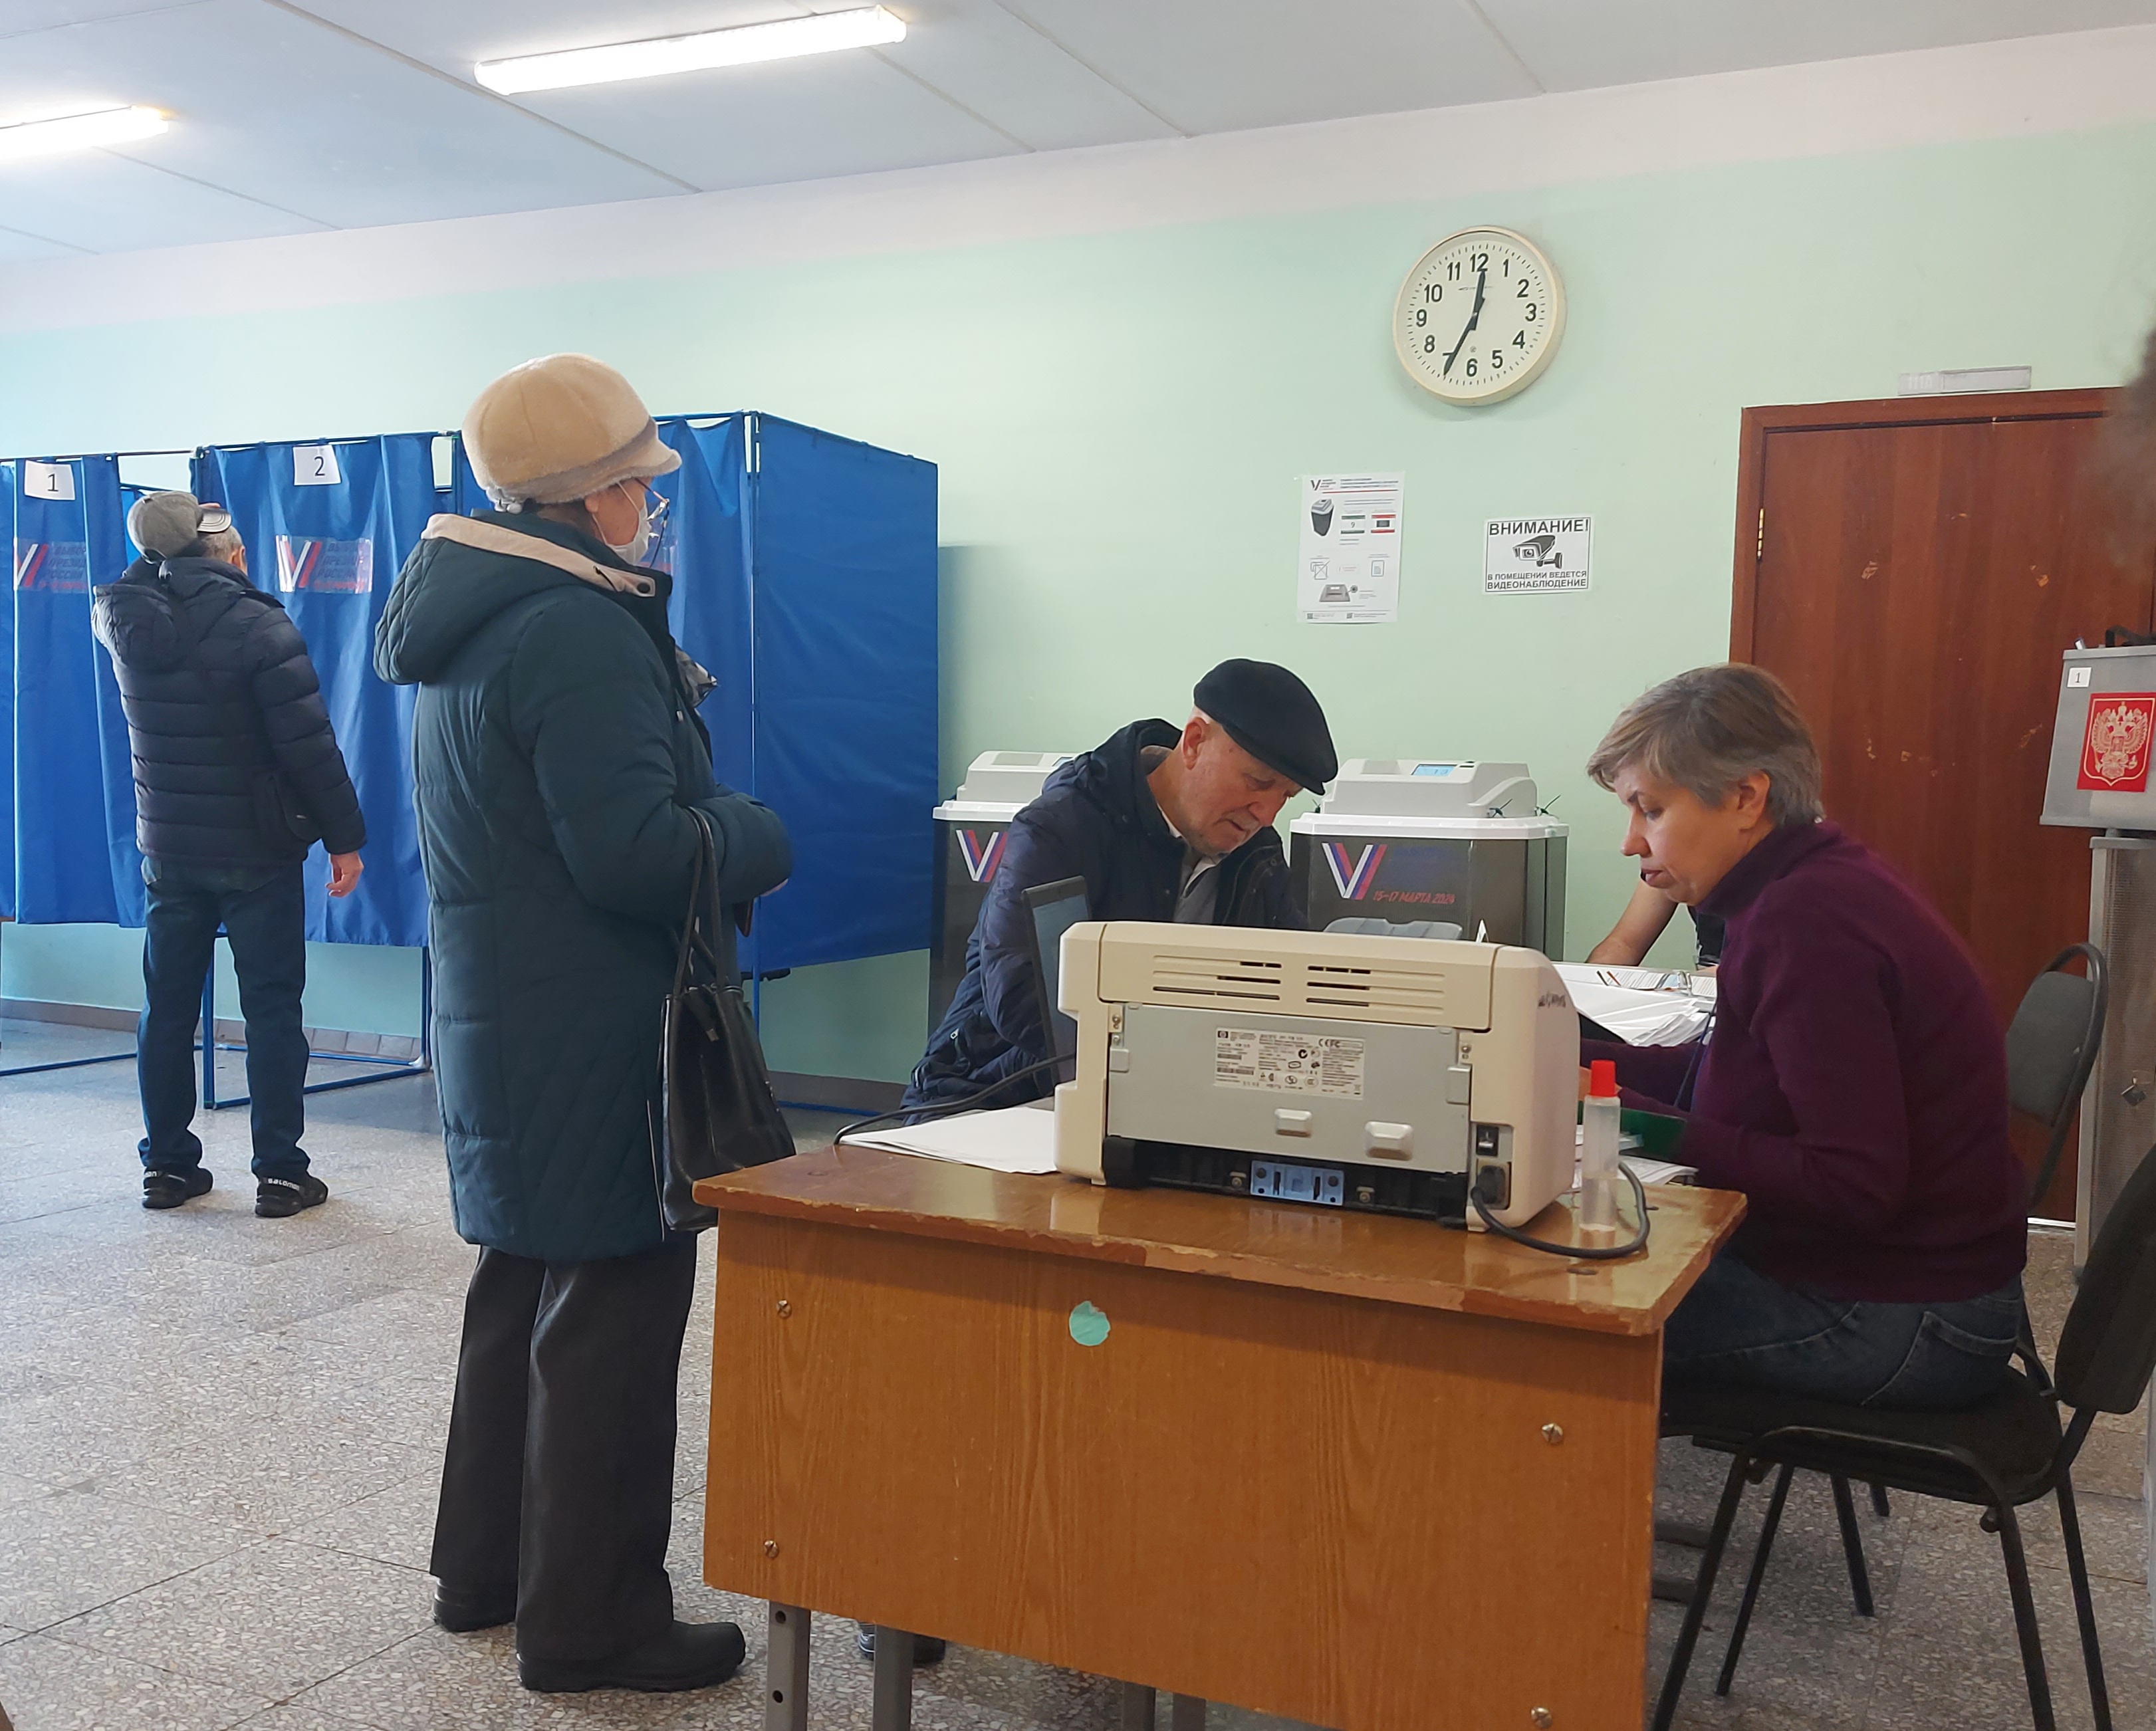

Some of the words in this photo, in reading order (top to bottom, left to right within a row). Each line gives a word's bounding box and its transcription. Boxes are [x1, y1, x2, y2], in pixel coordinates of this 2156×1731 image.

[1447, 261, 1461, 281] 11
[1469, 253, 1489, 273] 12
[1502, 258, 1509, 277] 1
[1423, 283, 1443, 303] 10
[1516, 279, 1529, 298] 2
[1415, 308, 1427, 327] 9
[1524, 302, 1537, 322] 3
[1423, 334, 1435, 353] 8
[1512, 330, 1525, 349] 4
[1466, 358, 1478, 377] 6
[1491, 350, 1503, 368] 5
[314, 456, 325, 476] 2
[47, 473, 59, 492] 1
[1489, 519, 1589, 535] ВНИМАНИЕ!
[1487, 578, 1586, 590] ВИДЕОНАБЛЮДЕНИЕ
[1495, 572, 1548, 580] ПОМЕЩЕНИИ
[2075, 672, 2080, 683] 1
[1398, 891, 1432, 903] МАРТА
